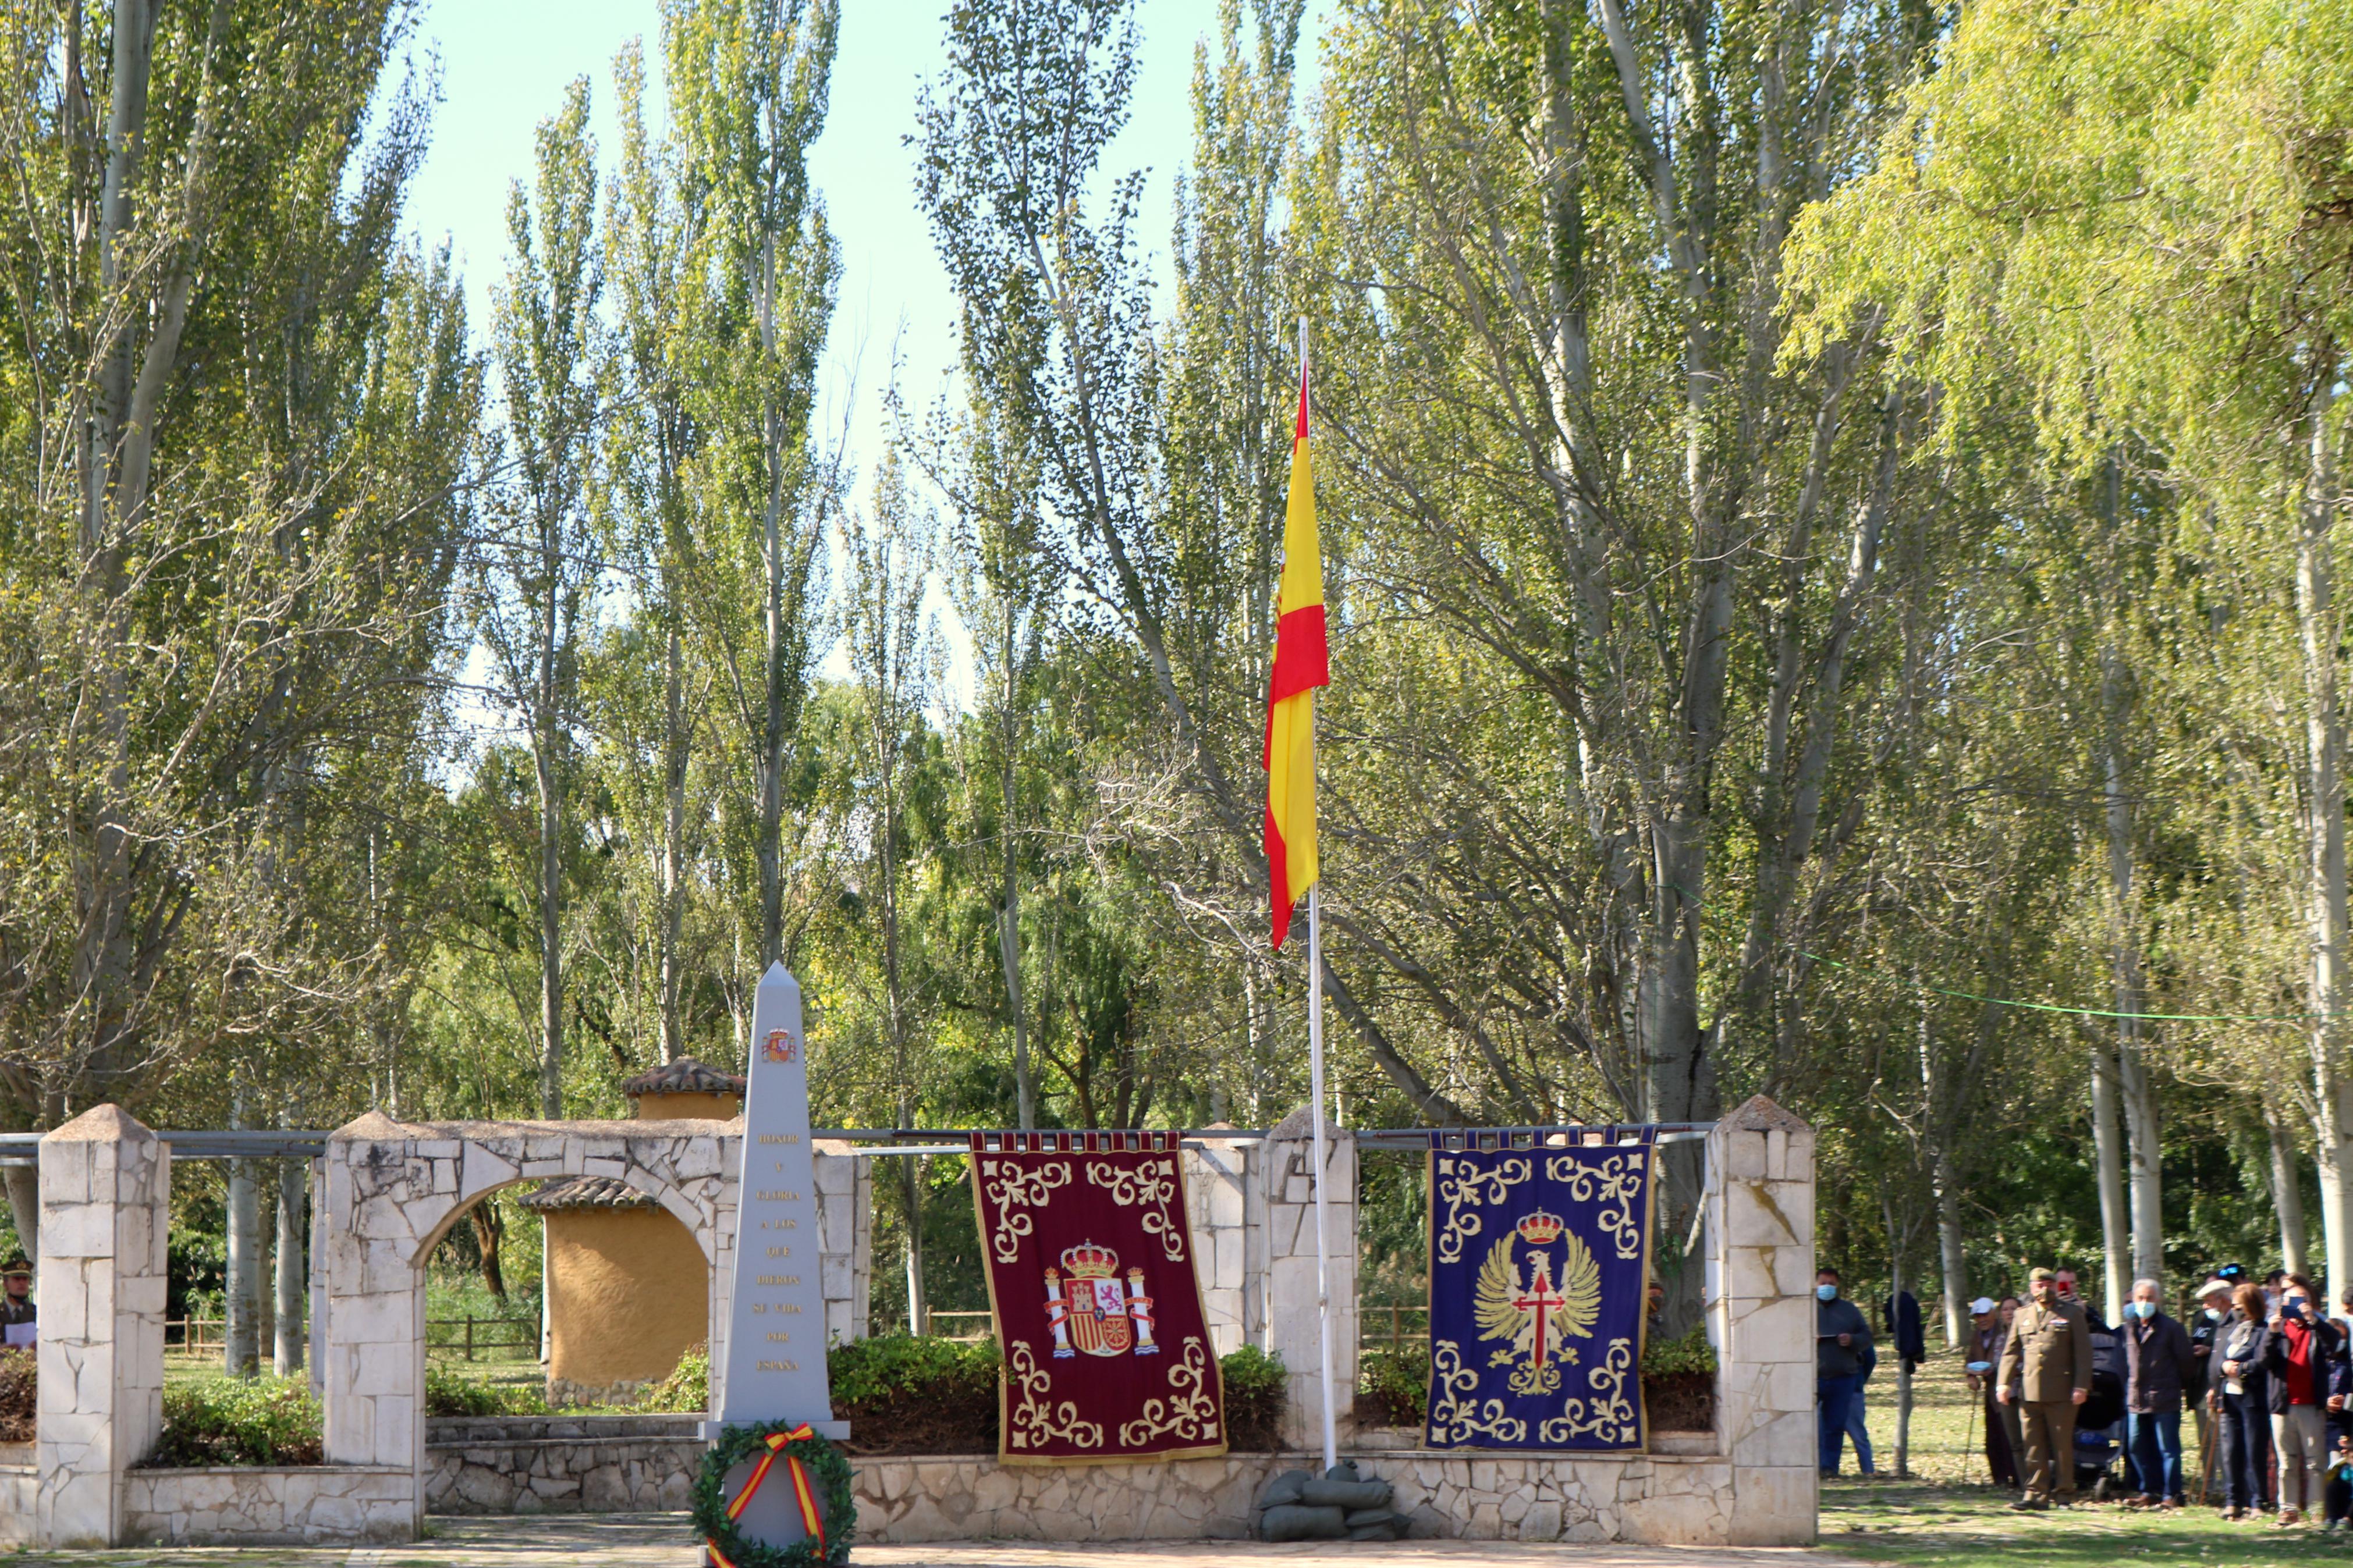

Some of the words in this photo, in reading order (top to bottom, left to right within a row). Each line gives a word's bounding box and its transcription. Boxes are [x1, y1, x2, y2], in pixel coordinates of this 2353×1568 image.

[759, 1135, 798, 1144] HONOR
[757, 1192, 800, 1201] GLORIA
[775, 1219, 796, 1229] LOS
[766, 1247, 790, 1257] QUE
[757, 1275, 800, 1285] DIERON
[753, 1304, 766, 1313] SU
[774, 1304, 801, 1313] VIDA
[767, 1332, 789, 1341] POR
[757, 1360, 799, 1370] ESPAÑA
